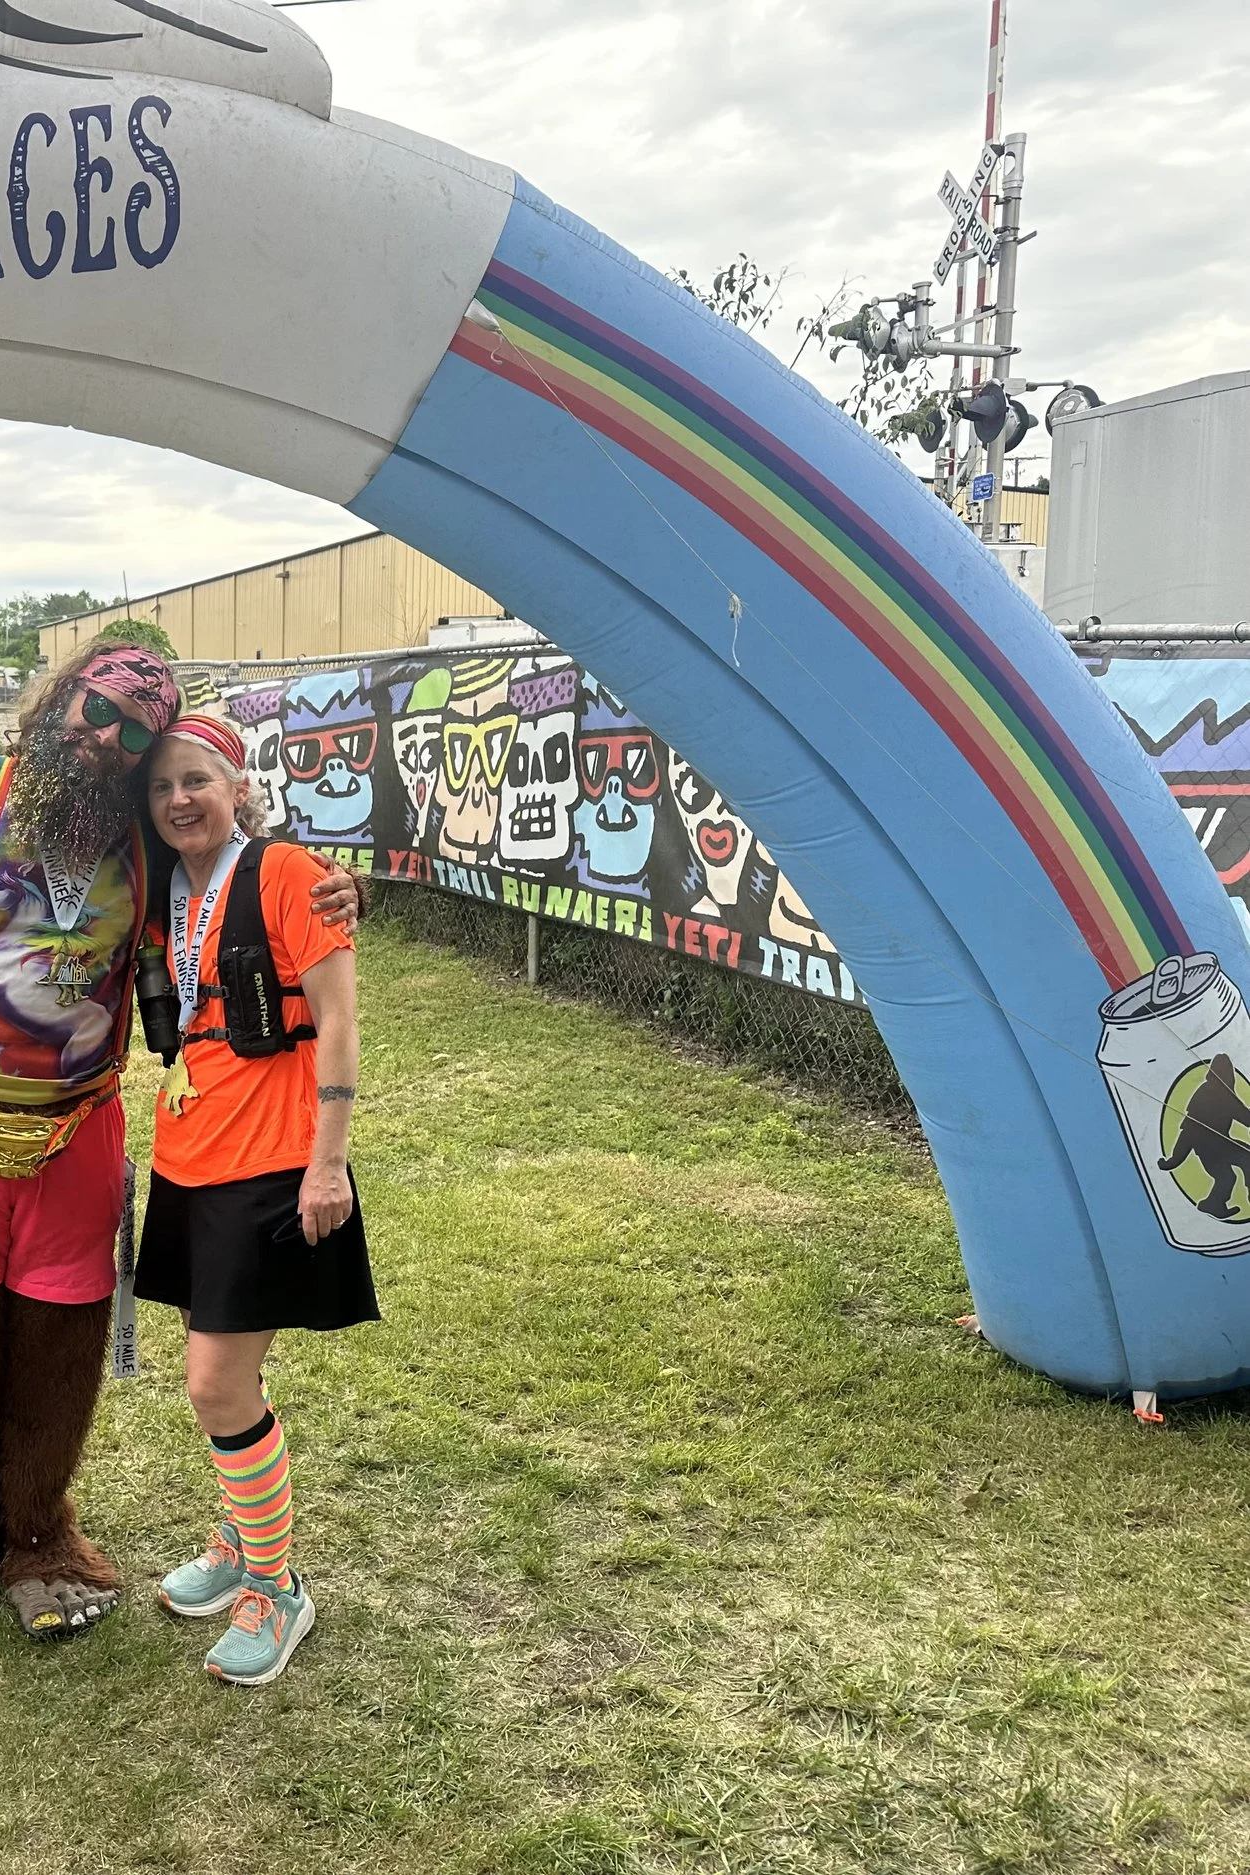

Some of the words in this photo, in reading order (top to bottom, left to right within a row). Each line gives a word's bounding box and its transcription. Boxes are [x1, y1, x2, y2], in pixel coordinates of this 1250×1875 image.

[937, 153, 992, 277] CROSSING
[174, 896, 186, 911] 50
[206, 889, 218, 904] 50
[174, 916, 186, 947] MILE
[195, 907, 210, 940] MILE
[387, 849, 432, 881] YETI
[433, 859, 495, 900] TRAIL
[501, 876, 653, 941] RUNNERS
[663, 912, 742, 969] YETI
[758, 936, 867, 1004] TRAI
[183, 944, 201, 1005] FINISHER
[256, 986, 271, 1037] NATHAN
[122, 1324, 134, 1339] 50
[122, 1344, 135, 1373] MILE
